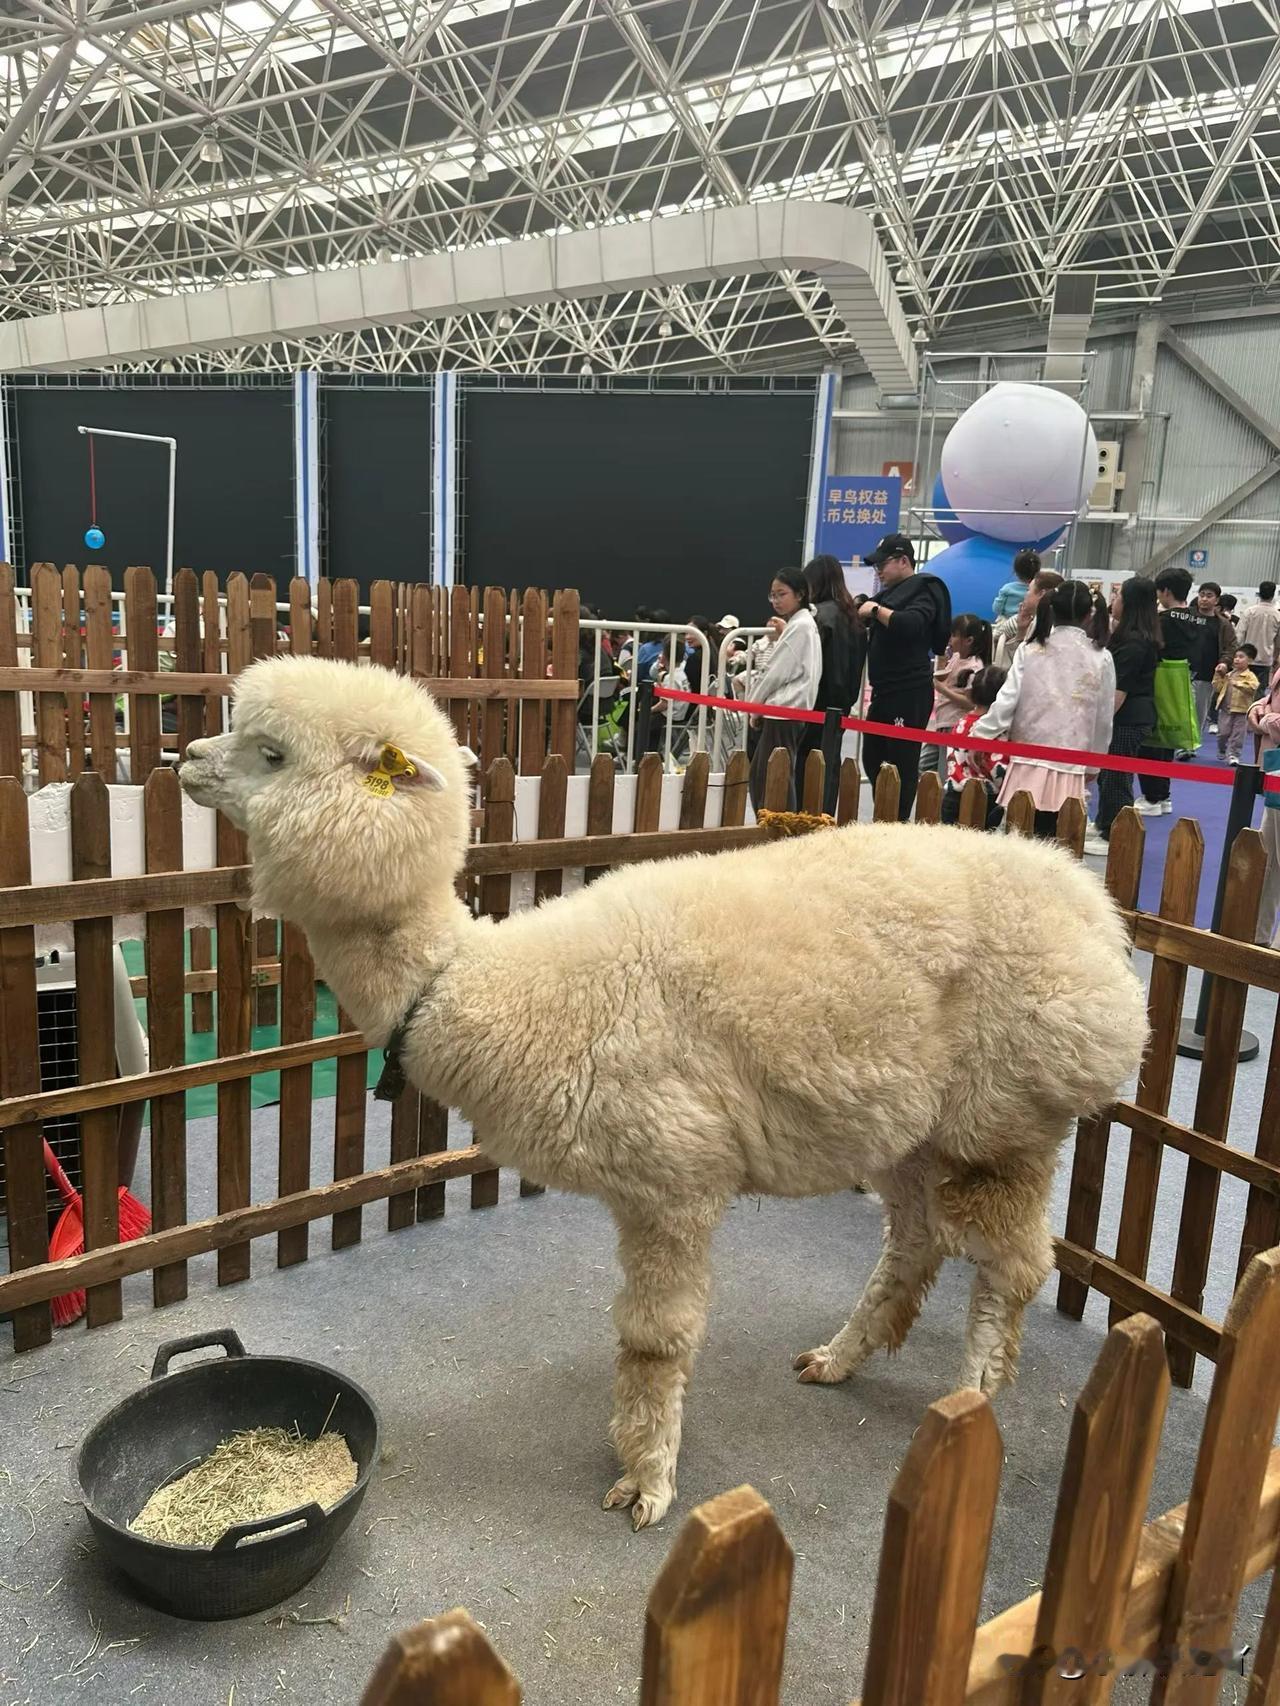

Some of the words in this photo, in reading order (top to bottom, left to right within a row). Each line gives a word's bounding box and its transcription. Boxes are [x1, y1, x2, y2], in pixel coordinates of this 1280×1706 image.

[828, 489, 889, 505] 早鸟权益
[822, 508, 887, 524] 币兑换处
[364, 775, 390, 790] 5198
